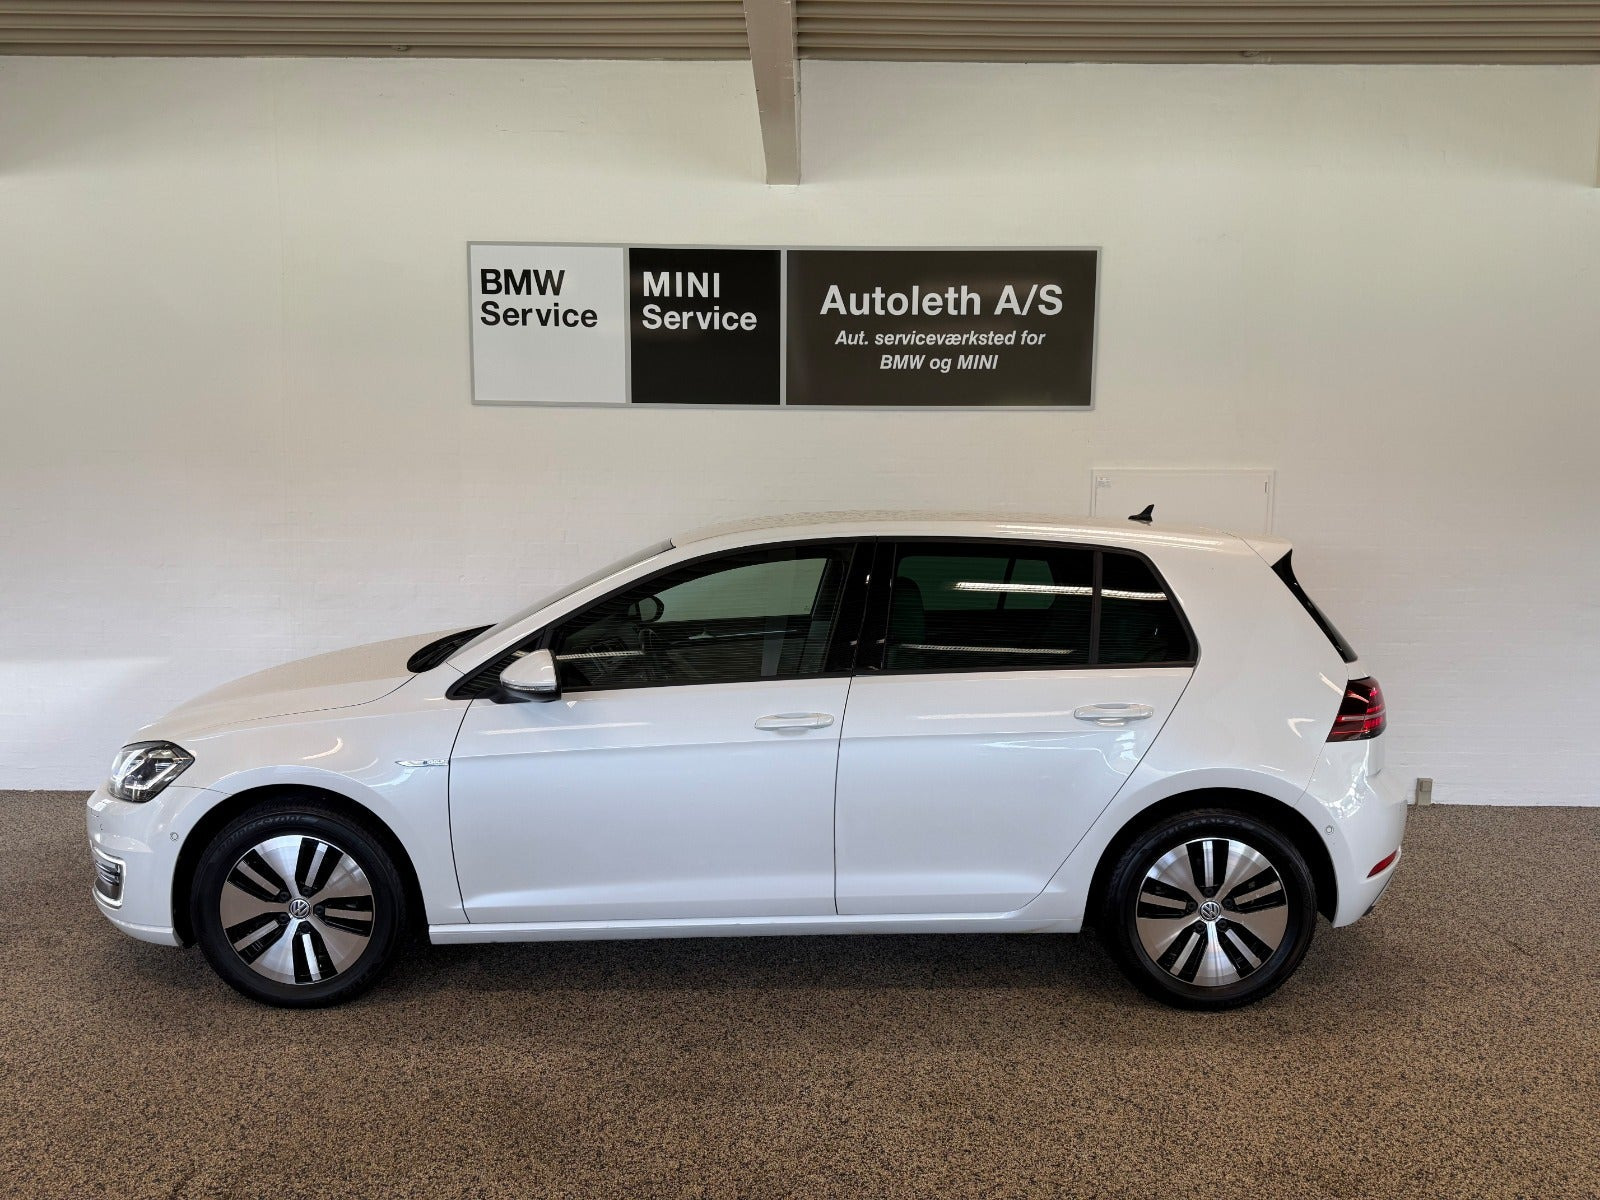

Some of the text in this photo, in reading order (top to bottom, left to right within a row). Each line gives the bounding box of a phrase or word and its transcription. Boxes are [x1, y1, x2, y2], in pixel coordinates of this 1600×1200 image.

[480, 268, 565, 296] BMW
[643, 271, 720, 298] MINI
[819, 283, 1063, 316] Autoleth A/S
[480, 302, 598, 328] Service
[642, 303, 758, 331] Service
[834, 329, 1047, 346] Aut. serviceværksted for
[879, 354, 999, 374] BMW og MINI
[289, 898, 310, 919] VW
[1199, 901, 1220, 921] VW
